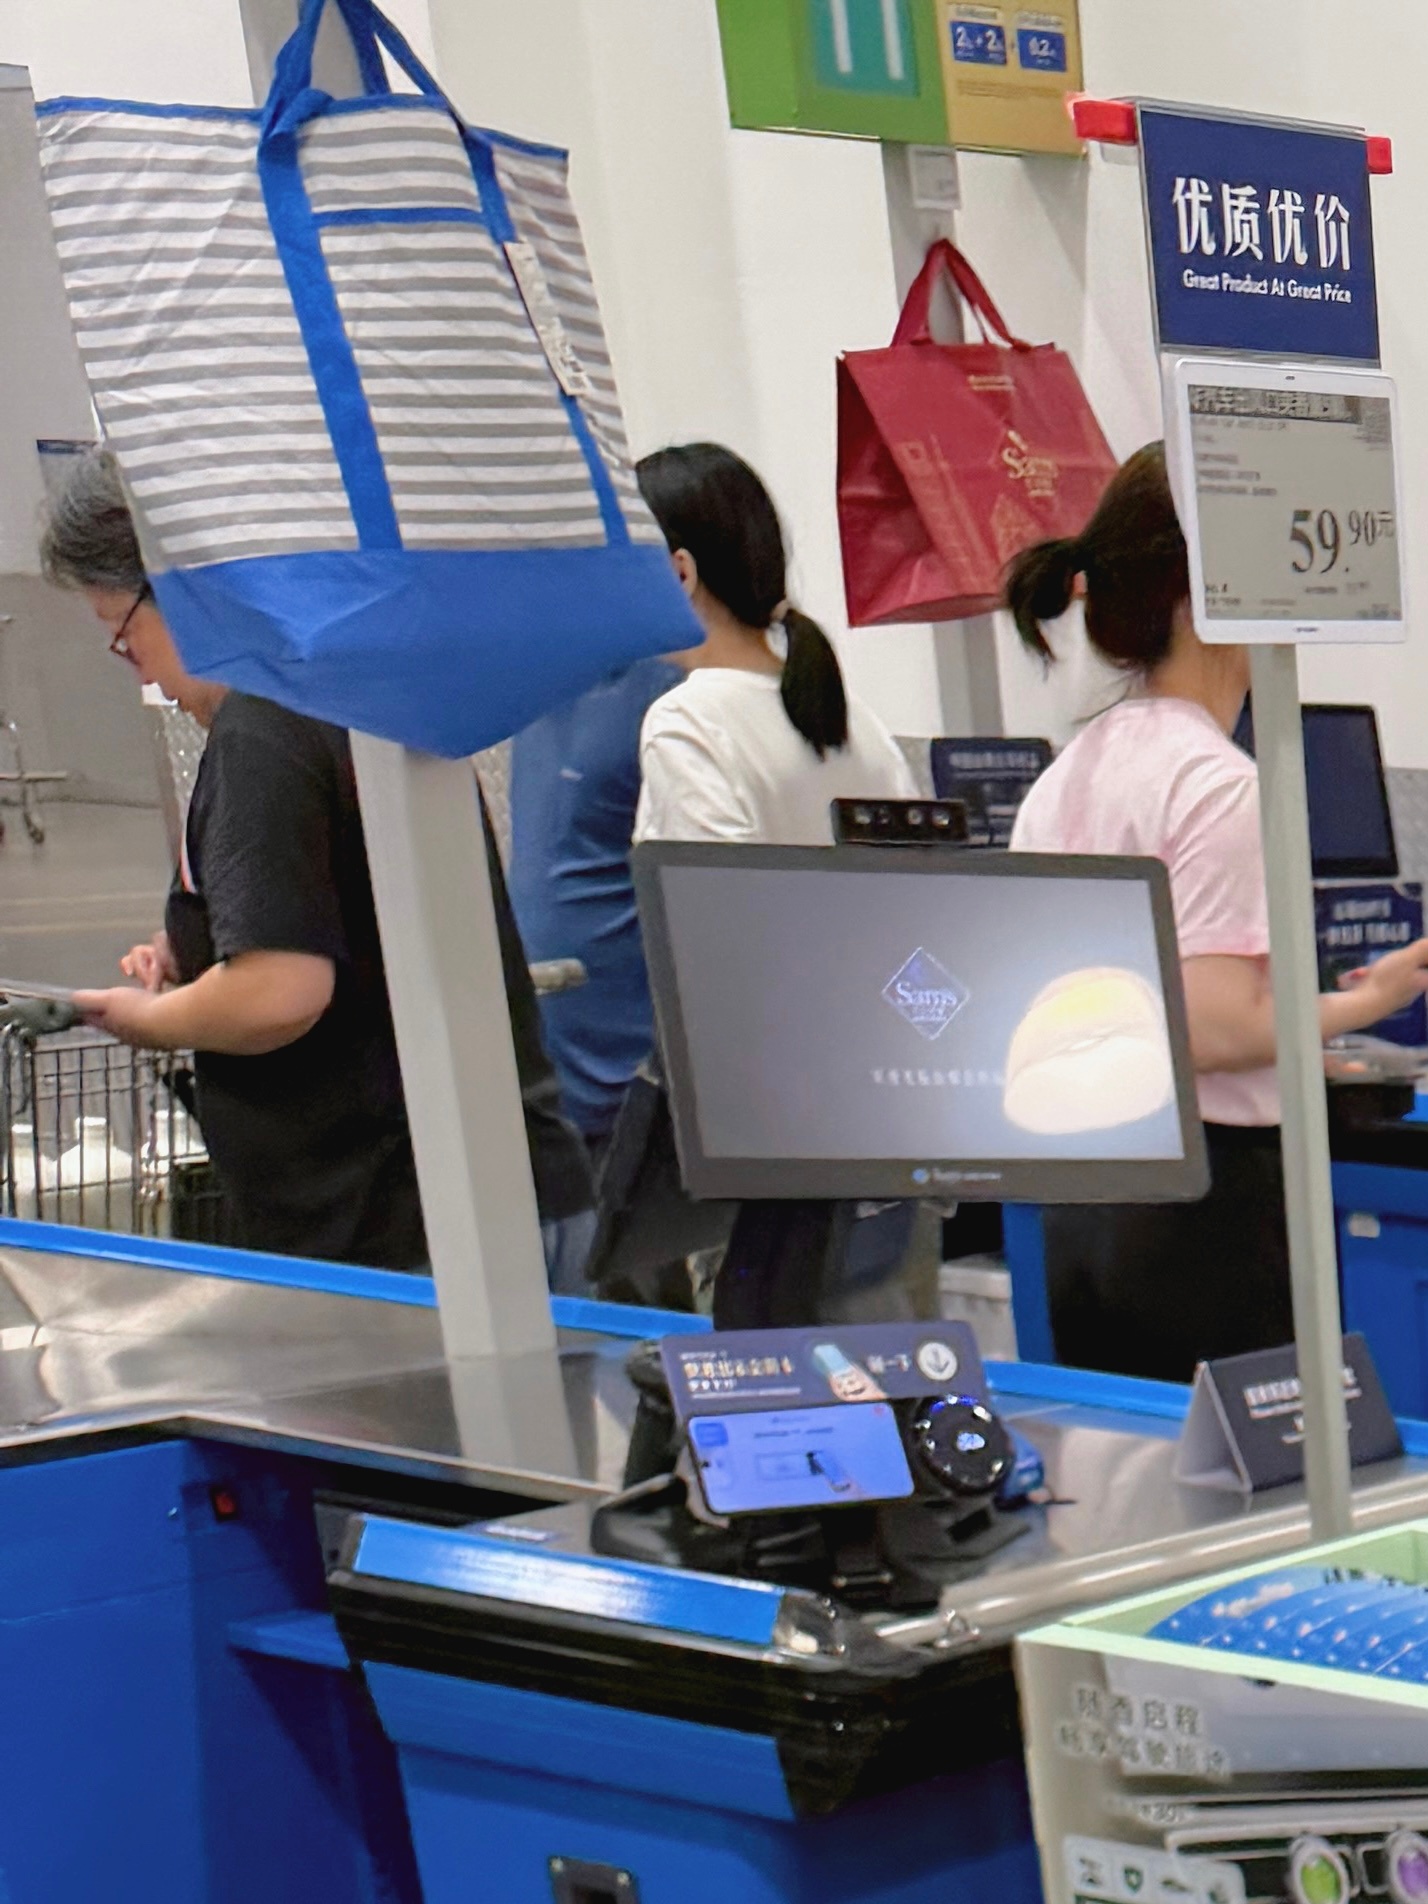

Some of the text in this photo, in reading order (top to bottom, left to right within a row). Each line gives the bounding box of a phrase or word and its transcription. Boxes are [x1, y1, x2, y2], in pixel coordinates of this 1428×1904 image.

[1172, 177, 1351, 271] 优质优价
[1183, 269, 1352, 304] Great Product At Great Price
